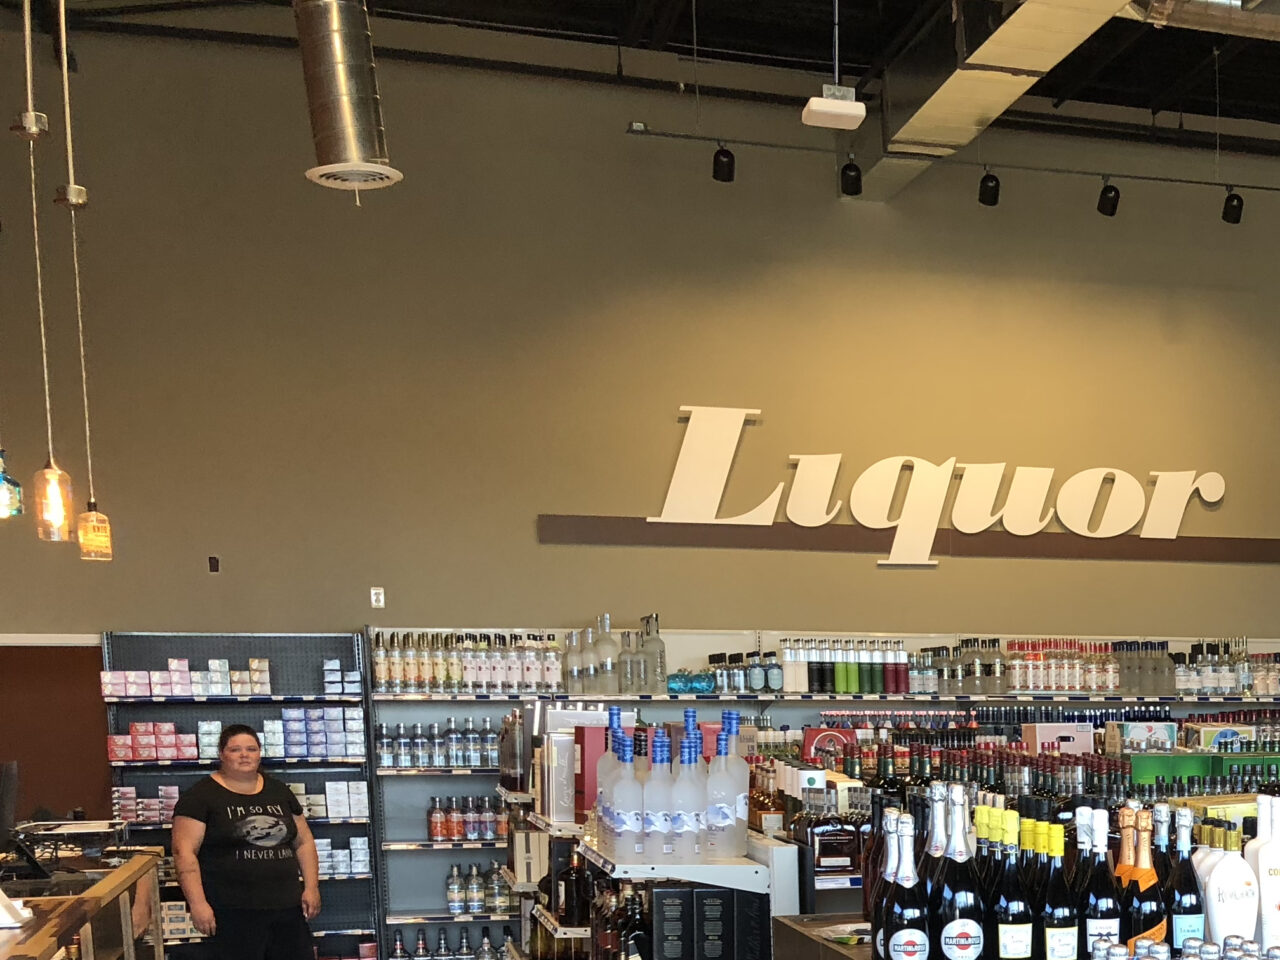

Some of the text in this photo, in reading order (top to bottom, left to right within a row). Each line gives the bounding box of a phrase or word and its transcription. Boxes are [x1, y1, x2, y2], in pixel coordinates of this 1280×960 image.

[646, 405, 1226, 566] Liquor
[226, 804, 284, 819] I'M SO FLY
[243, 849, 275, 859] NEVER
